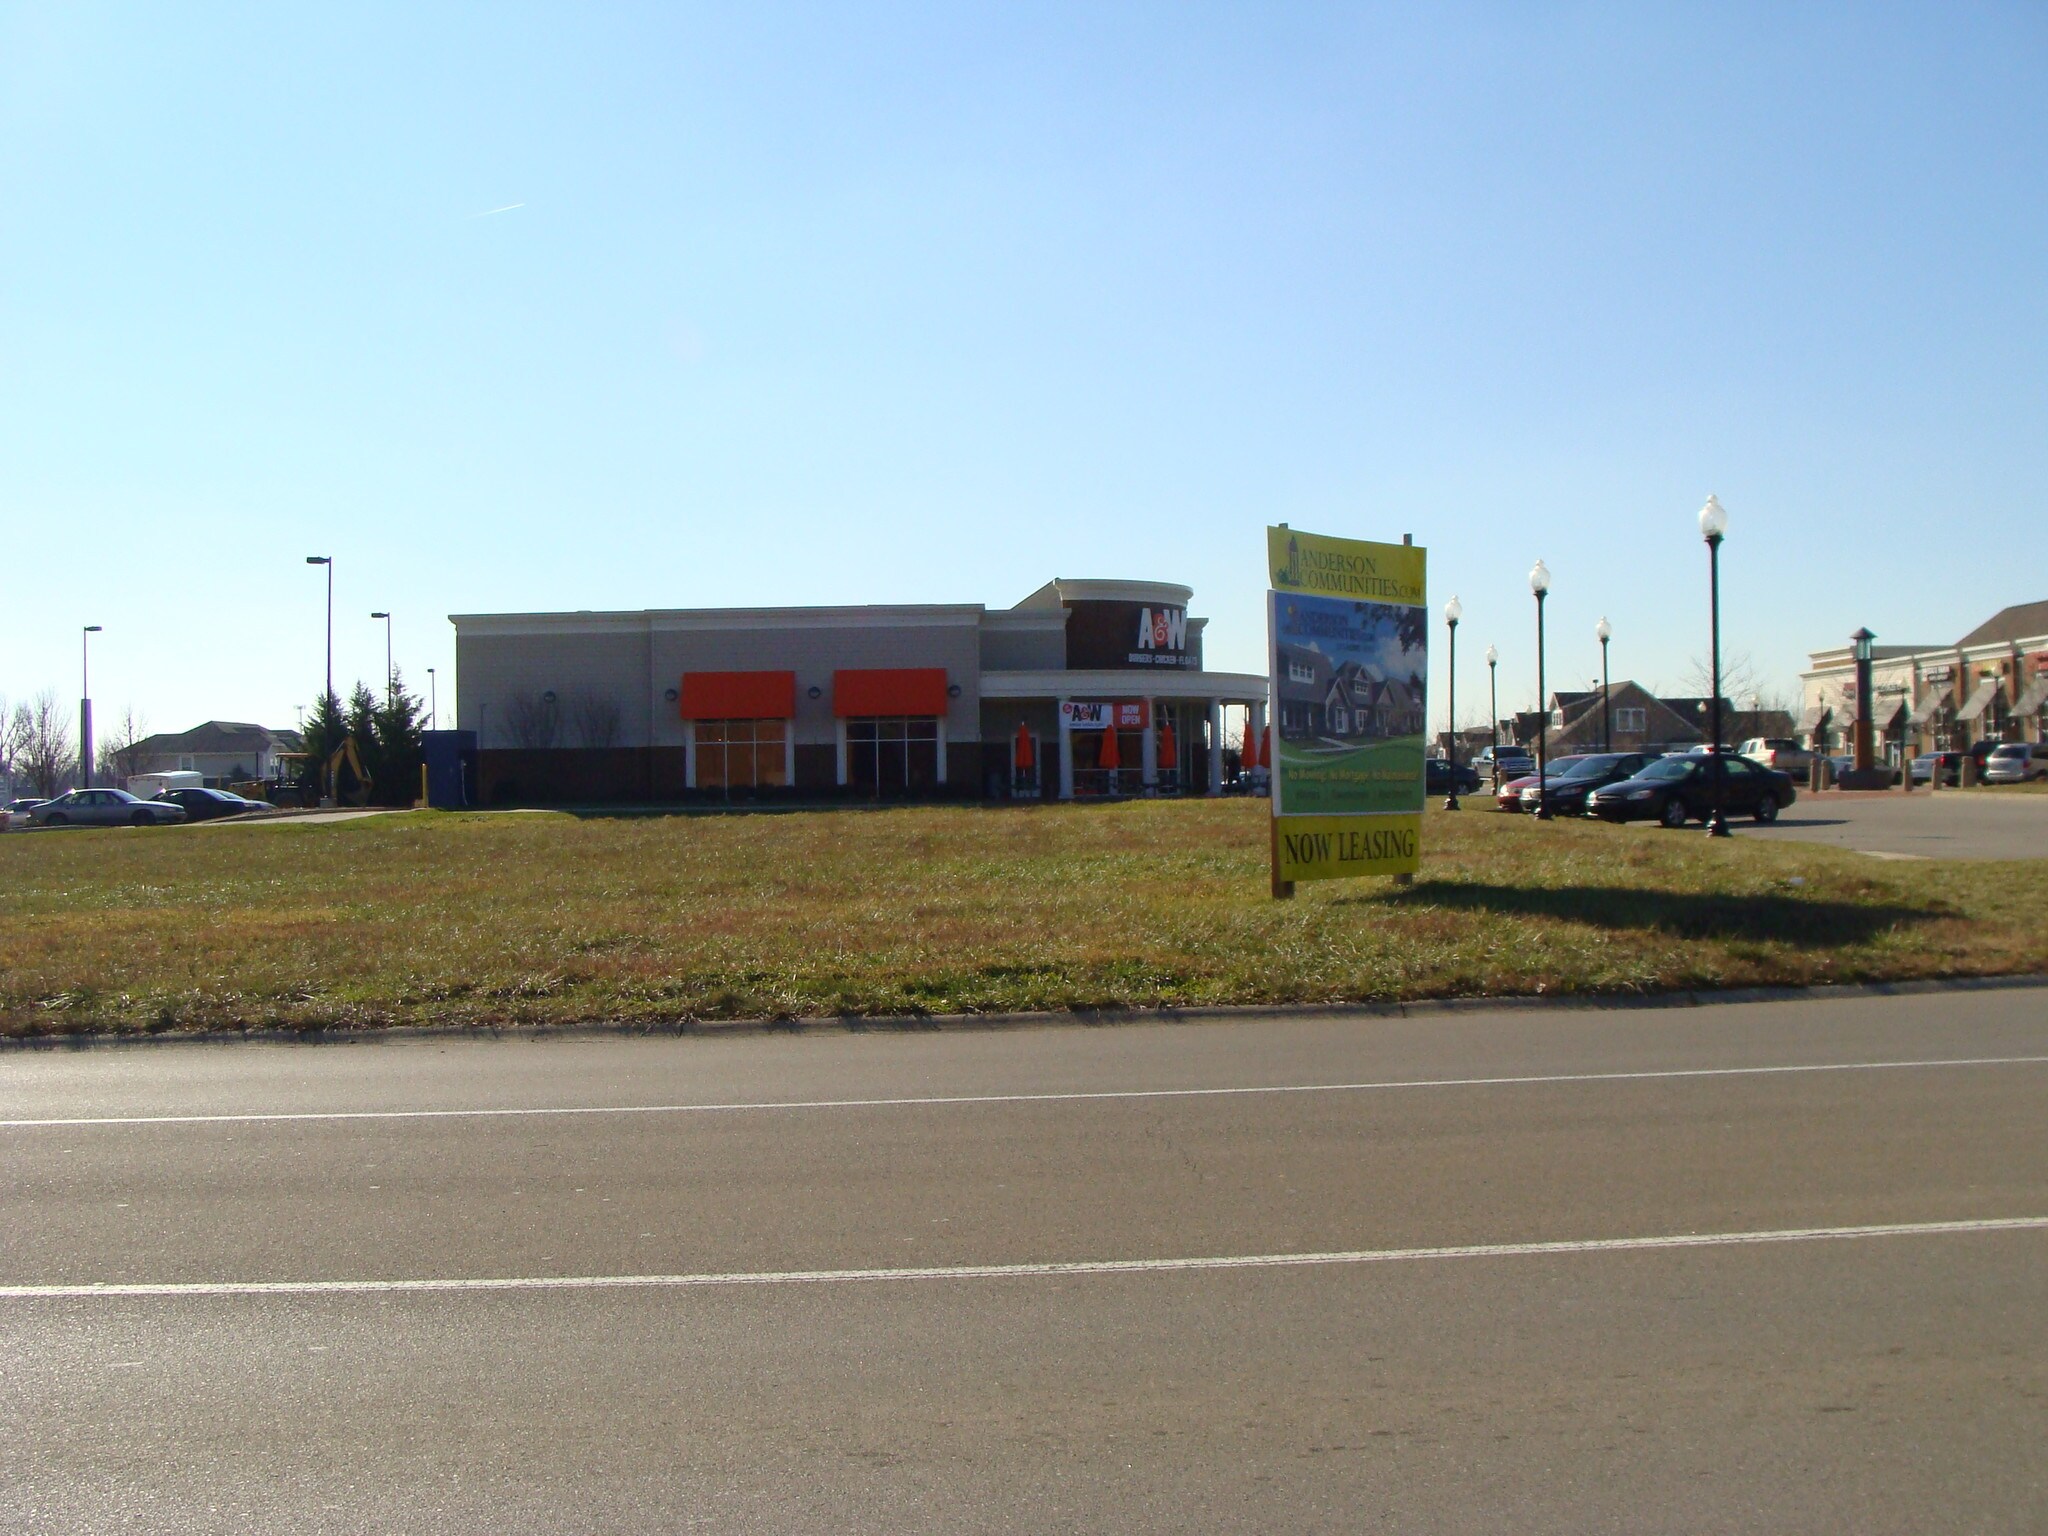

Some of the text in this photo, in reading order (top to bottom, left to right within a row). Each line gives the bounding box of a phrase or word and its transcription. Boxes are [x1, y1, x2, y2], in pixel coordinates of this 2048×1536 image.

[1300, 549, 1376, 574] ANDERSON
[1138, 607, 1187, 650] A&W
[1071, 704, 1103, 721] A&W
[1121, 715, 1141, 724] OPEN
[1284, 829, 1414, 864] NOW LEASING
